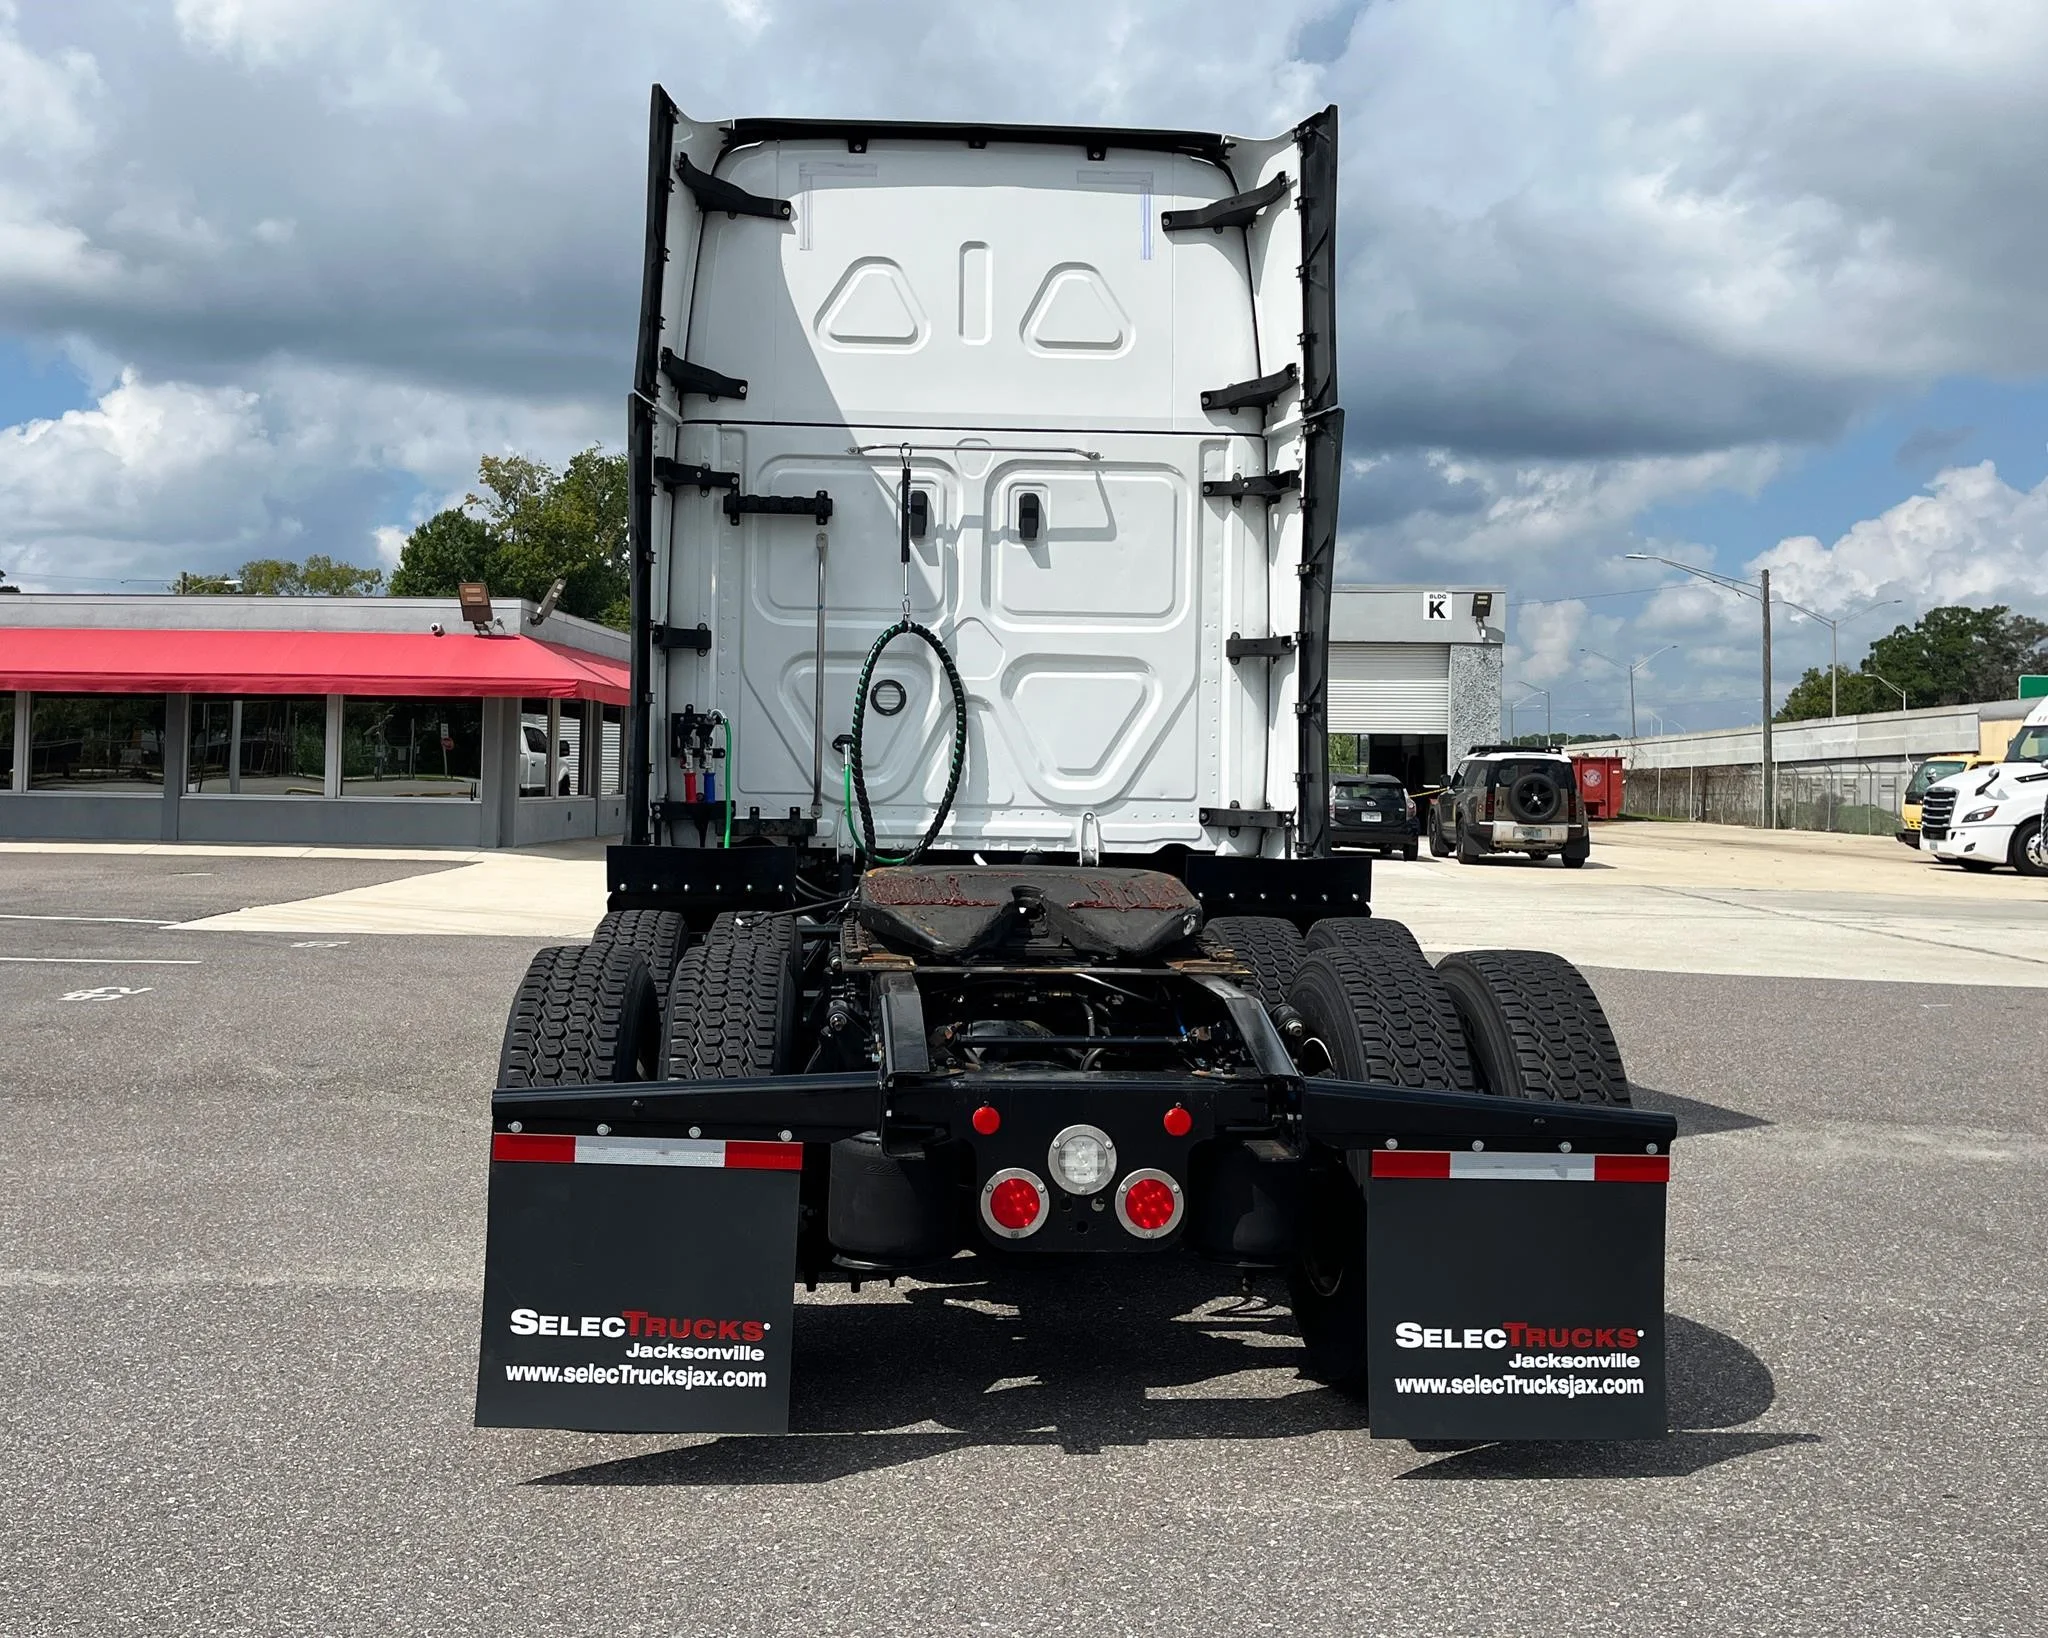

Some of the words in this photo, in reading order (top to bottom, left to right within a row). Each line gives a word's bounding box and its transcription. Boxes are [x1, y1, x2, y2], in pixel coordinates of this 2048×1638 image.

[1429, 600, 1446, 619] K
[626, 1343, 765, 1361] Jacksonville
[1508, 1353, 1640, 1368] Jacksonville
[505, 1363, 767, 1390] www.selecTrucksjax.com
[1395, 1374, 1644, 1399] www.selecTrucksjax.com
